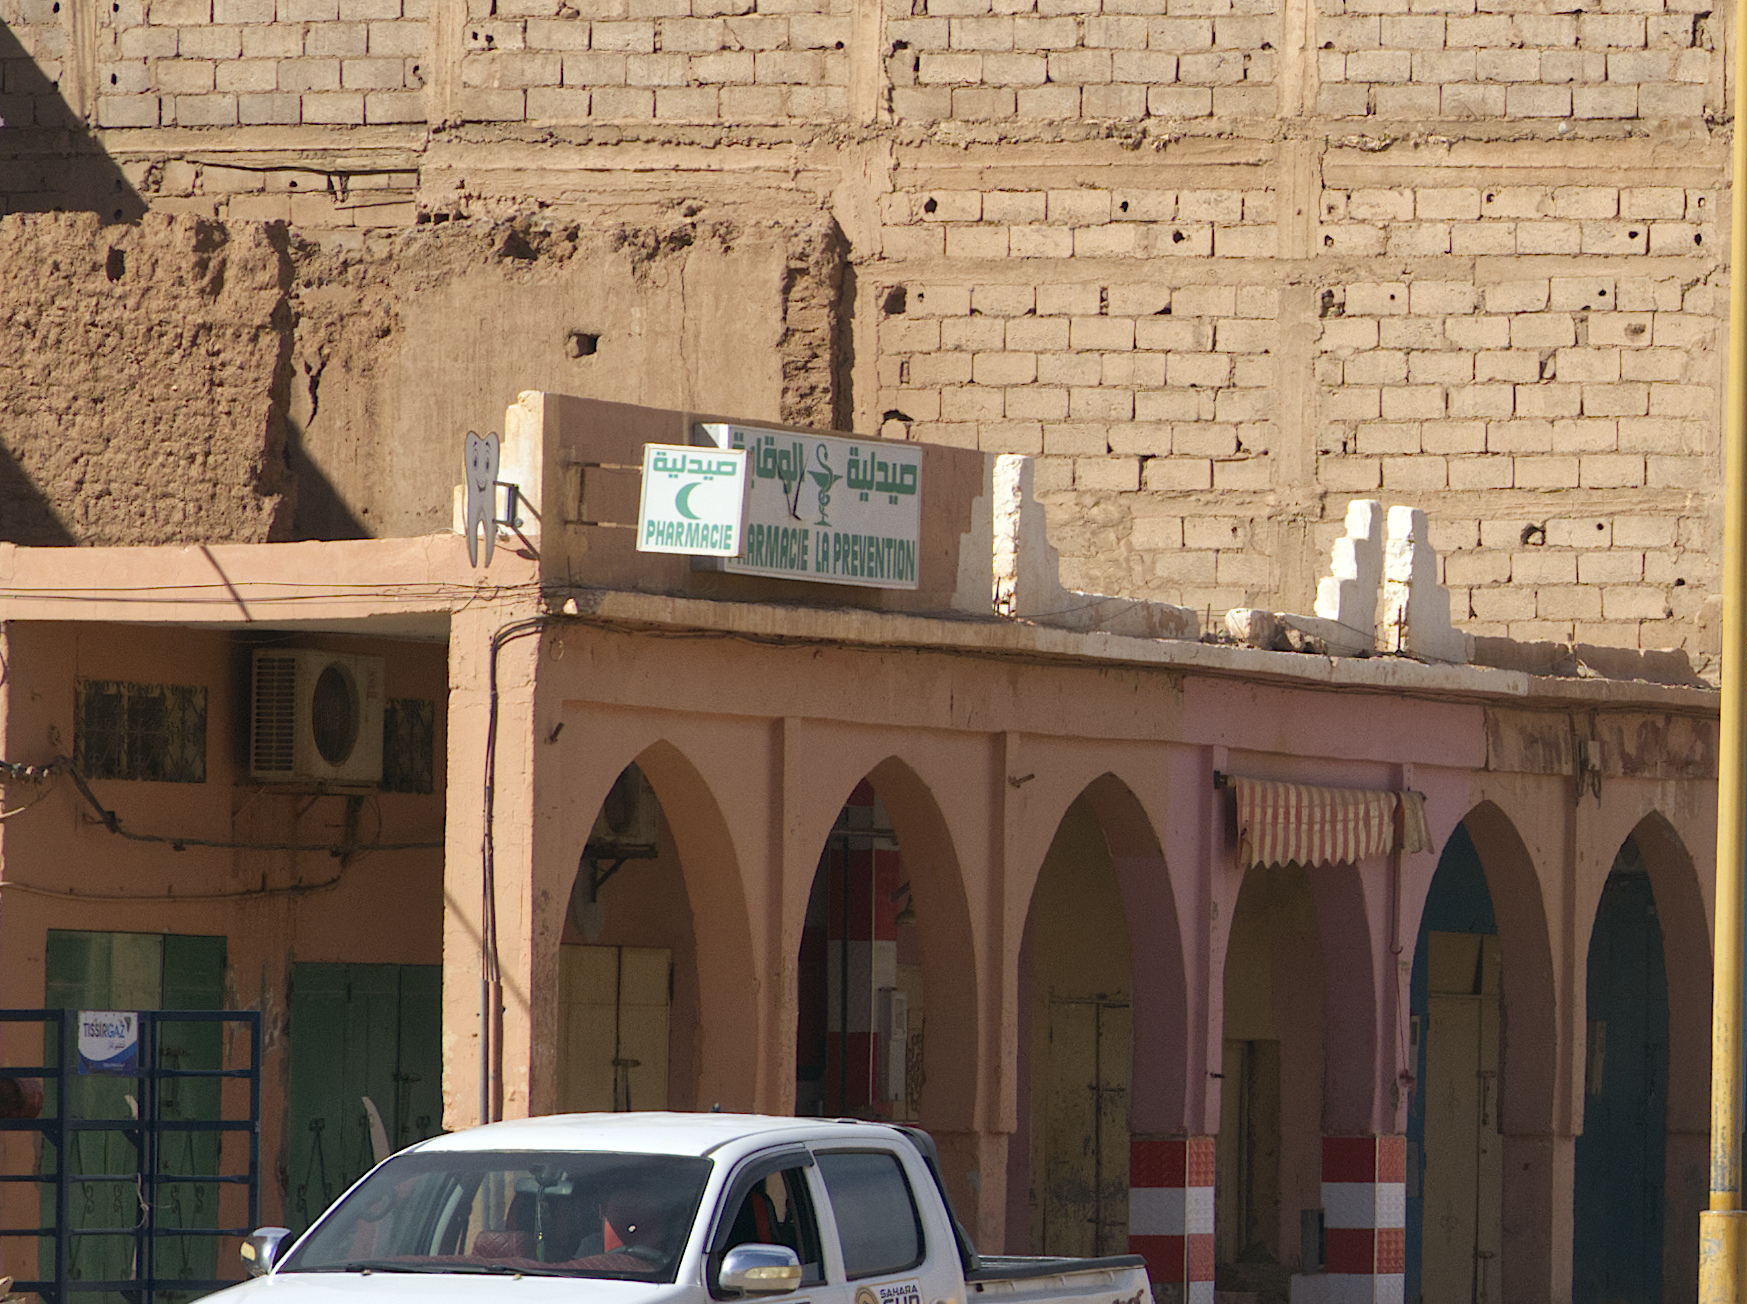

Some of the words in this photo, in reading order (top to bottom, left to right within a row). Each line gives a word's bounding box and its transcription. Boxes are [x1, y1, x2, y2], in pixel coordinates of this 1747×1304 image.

[653, 451, 737, 480] صيدلية
[733, 431, 805, 495] الوقا
[846, 446, 918, 505] صيدلية
[645, 519, 733, 551] PHARMACIE
[728, 522, 809, 572] ARMACIE
[815, 530, 830, 573] LA
[833, 532, 916, 582] PREVENTION
[879, 1284, 919, 1299] SAHARA
